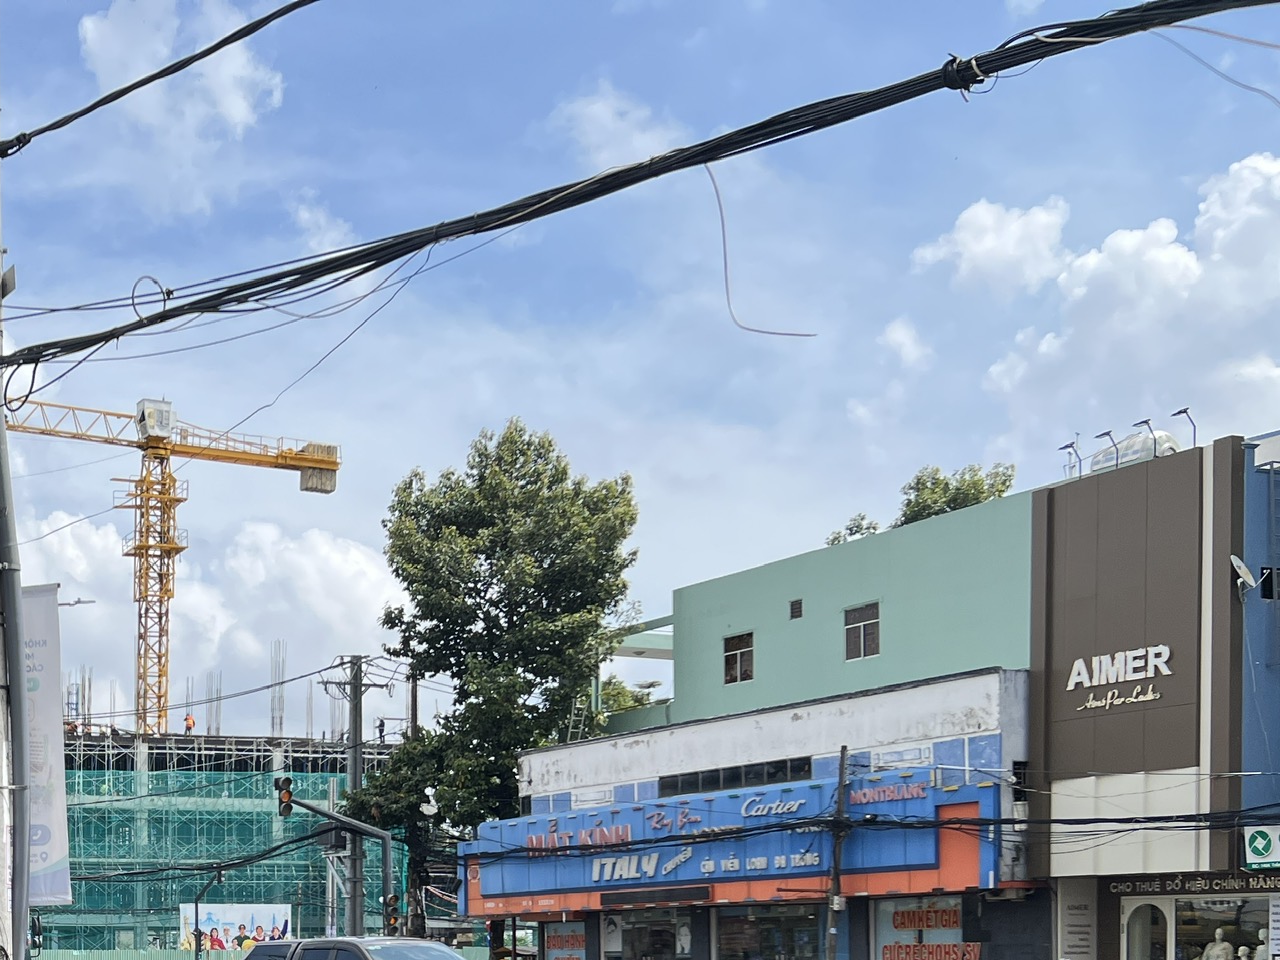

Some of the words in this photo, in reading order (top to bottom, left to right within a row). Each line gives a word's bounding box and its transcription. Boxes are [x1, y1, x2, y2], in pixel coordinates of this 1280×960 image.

[1066, 644, 1172, 691] AIMER
[850, 783, 927, 805] MONTBLANC
[741, 797, 806, 818] Cartier
[592, 853, 659, 882] ITALY
[1109, 882, 1132, 893] CHO
[1135, 879, 1161, 892] THUÊ
